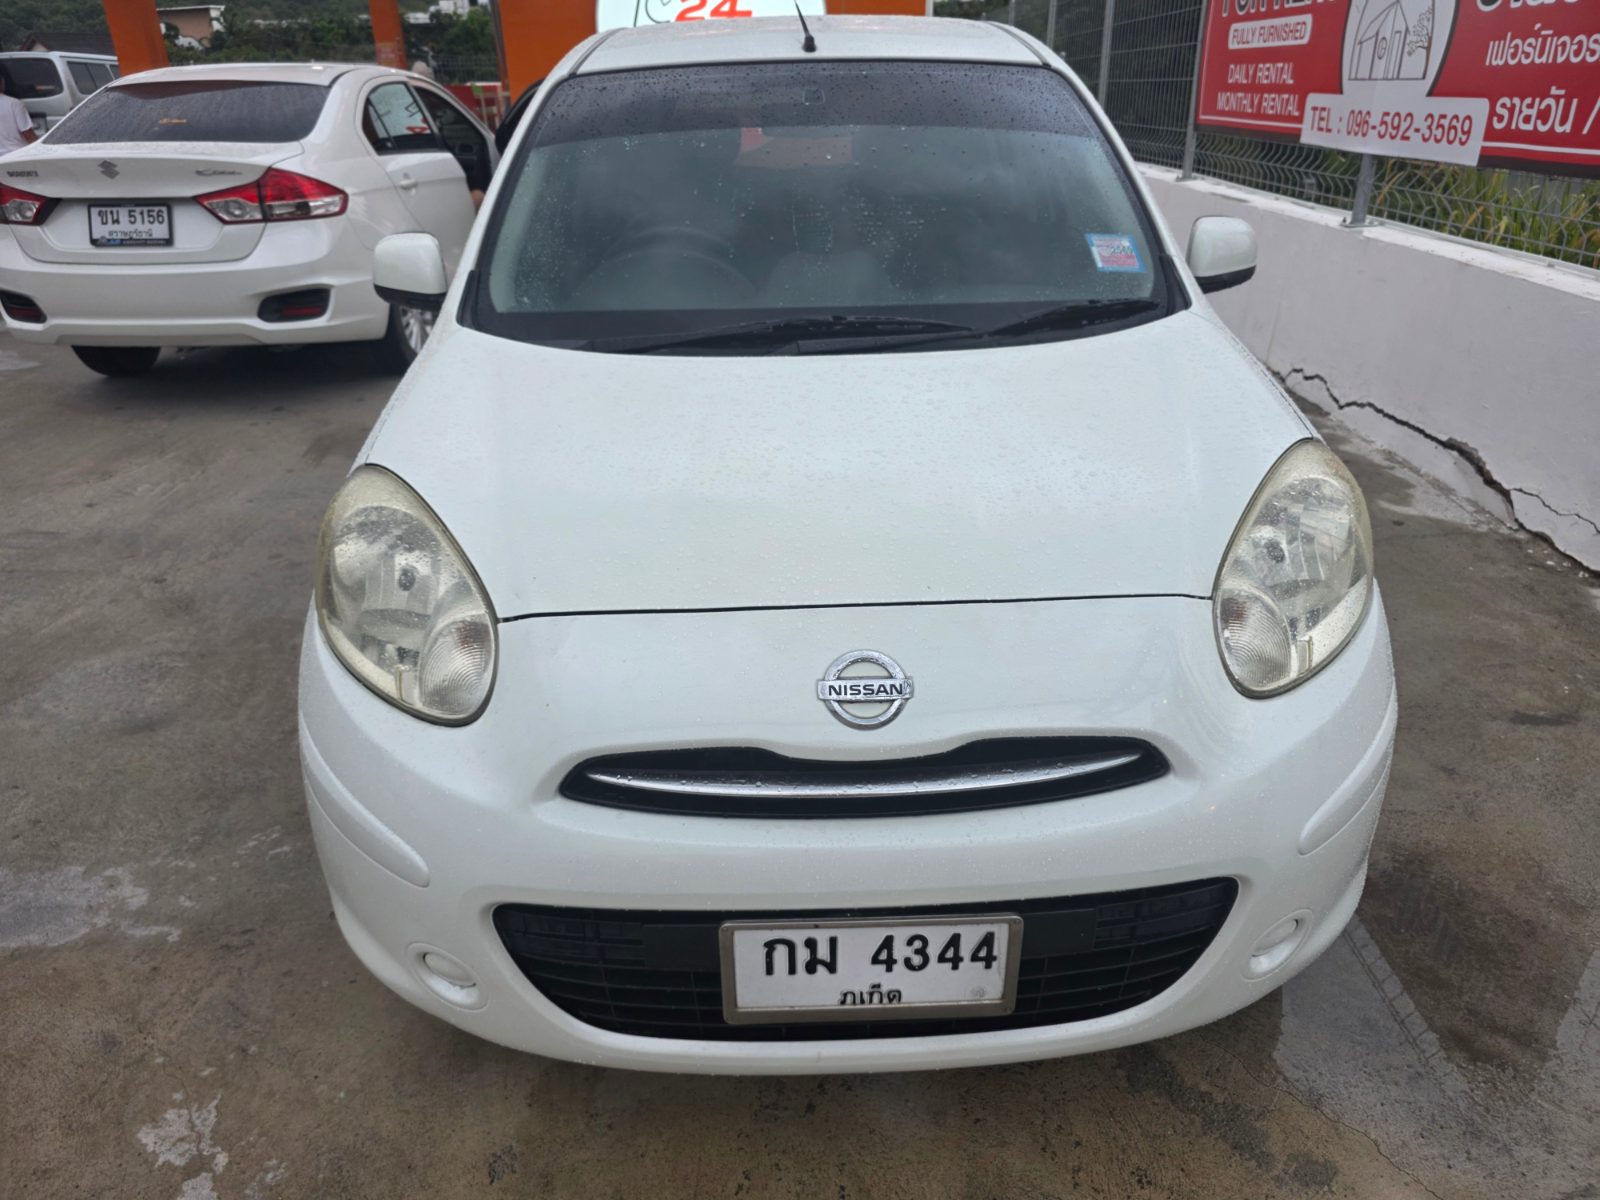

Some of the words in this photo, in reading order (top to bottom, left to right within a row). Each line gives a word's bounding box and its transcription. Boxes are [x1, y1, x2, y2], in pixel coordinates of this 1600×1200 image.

[1231, 28, 1257, 45] FULLY
[1258, 21, 1307, 43] FURNISHED
[1227, 64, 1256, 84] DAILY
[1256, 62, 1295, 84] RENTAL
[1216, 92, 1261, 113] MONTHLY
[1261, 93, 1300, 116] RENTAL
[1492, 85, 1578, 133] รายวัน
[1346, 109, 1474, 146] 096-592-3569
[128, 208, 165, 225] 5156
[828, 683, 903, 696] NISSAN
[763, 935, 838, 976] กม
[871, 931, 997, 973] 4344
